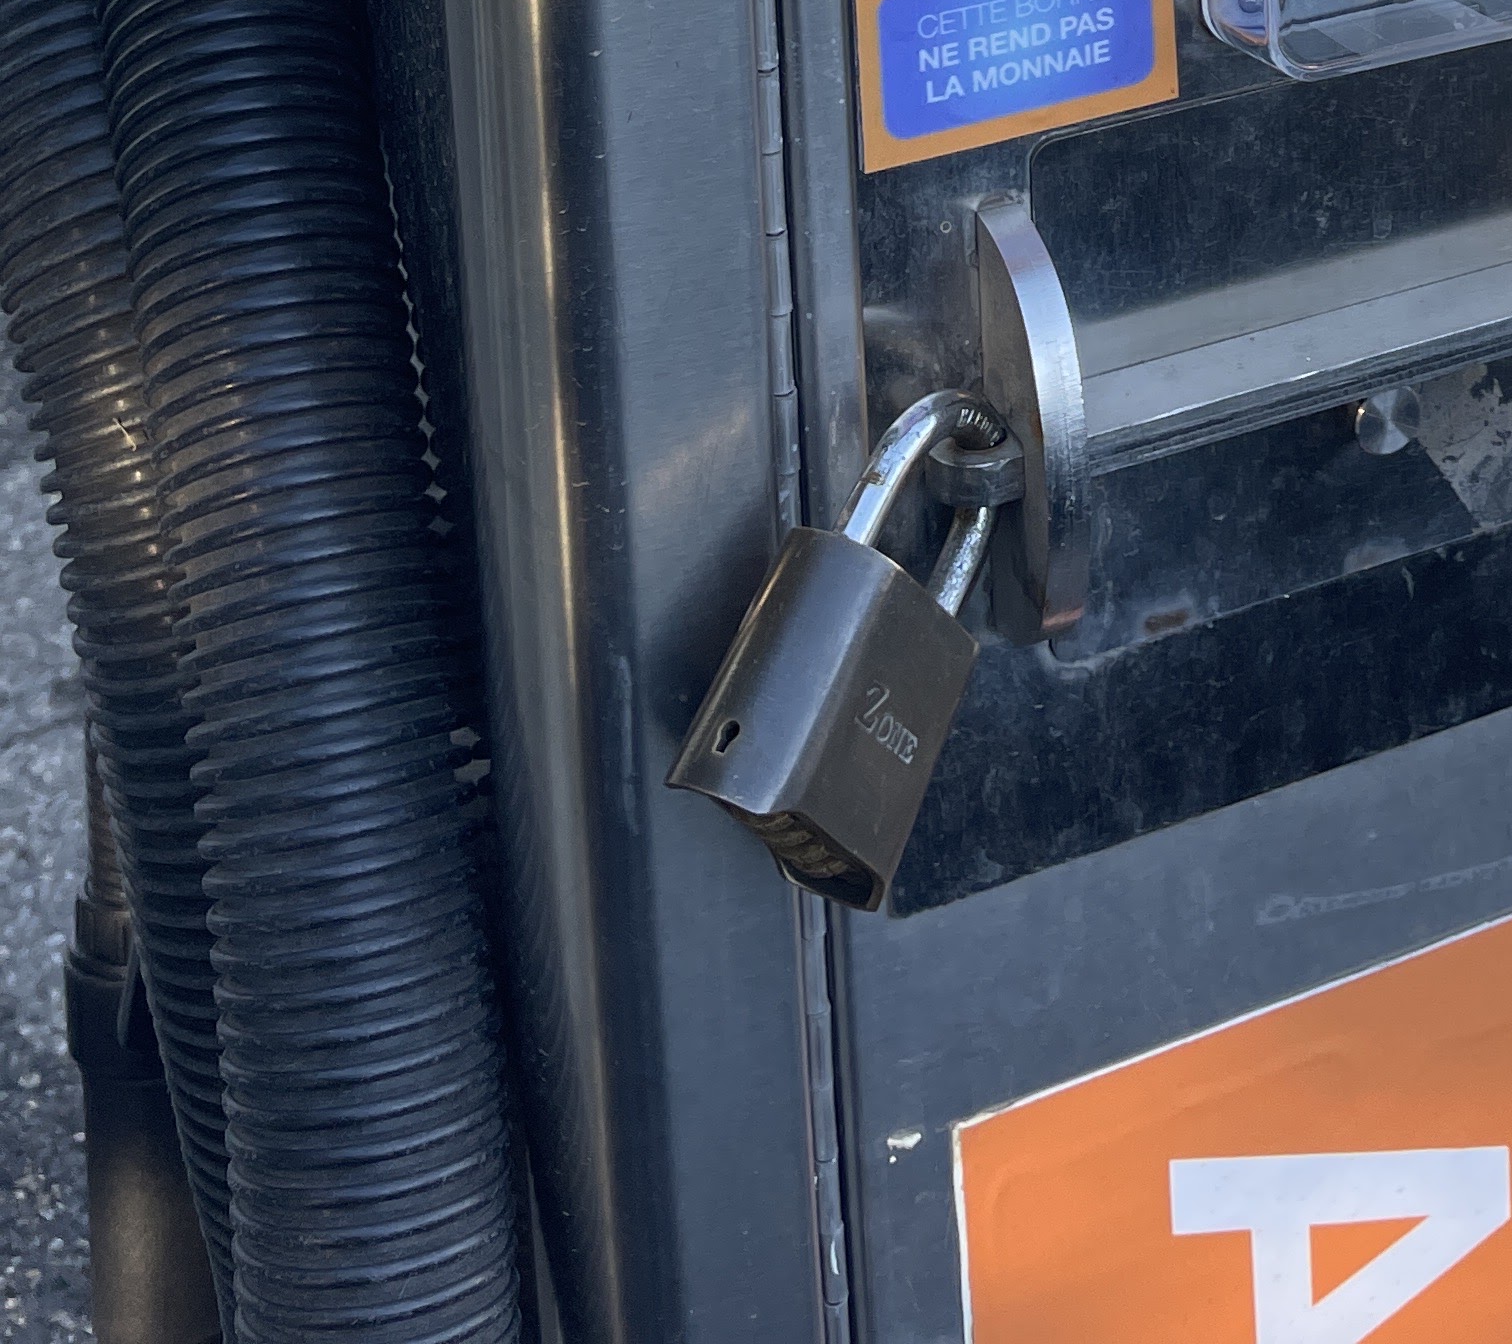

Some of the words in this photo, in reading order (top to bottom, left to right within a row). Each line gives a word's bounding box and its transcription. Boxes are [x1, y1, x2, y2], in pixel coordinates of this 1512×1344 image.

[917, 0, 1007, 39] CETTE
[919, 42, 961, 72] NE
[968, 23, 1050, 61] REND
[1060, 7, 1115, 40] PAS
[926, 75, 965, 103] LA
[972, 39, 1111, 93] MONNAIE
